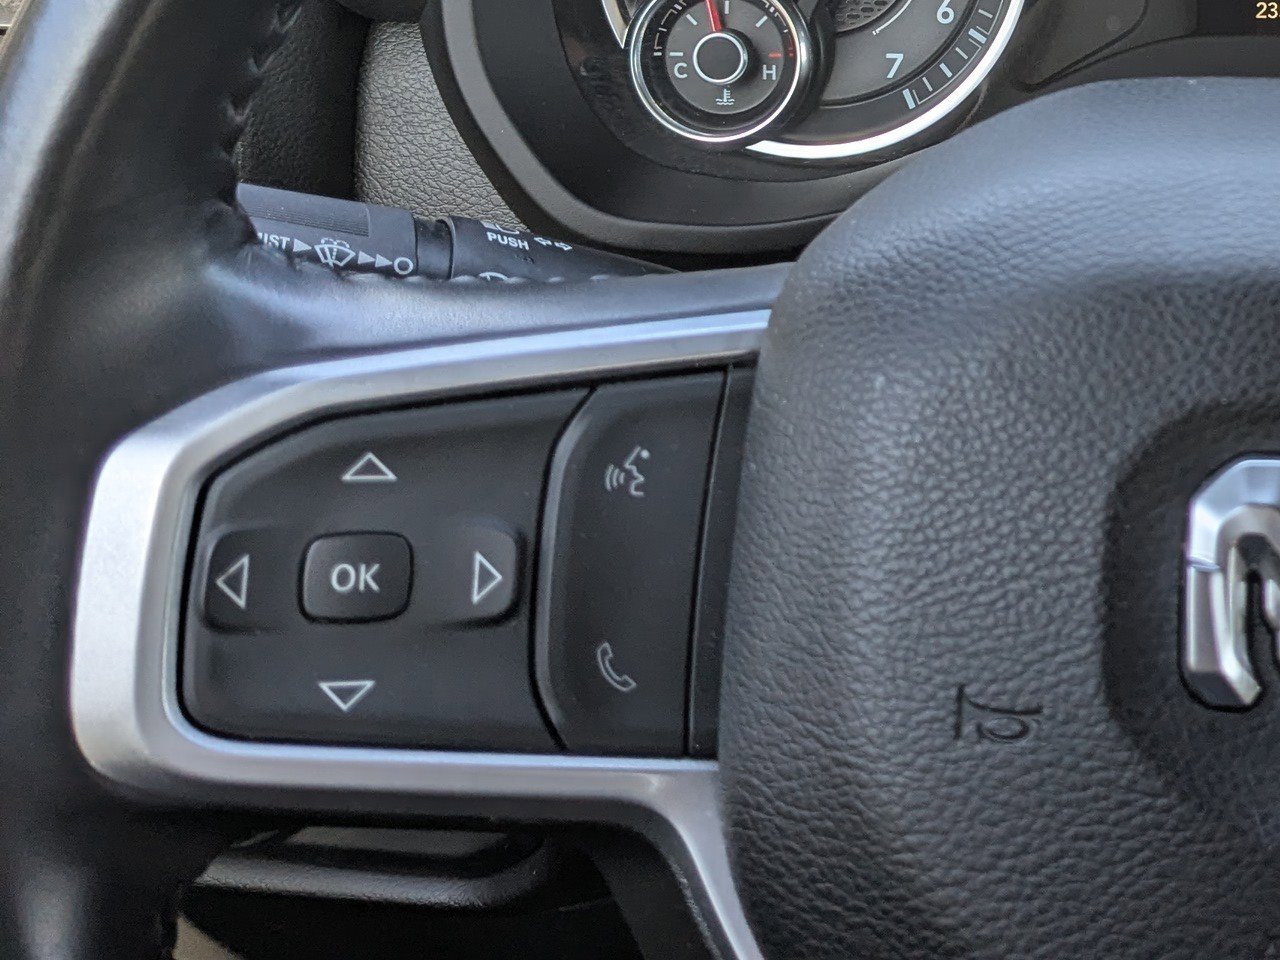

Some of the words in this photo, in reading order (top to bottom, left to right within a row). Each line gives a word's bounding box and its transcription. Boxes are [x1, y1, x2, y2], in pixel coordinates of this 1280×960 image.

[936, 0, 954, 23] 6
[673, 62, 688, 78] C
[762, 65, 777, 80] H
[886, 54, 904, 79] 7
[486, 231, 530, 251] PUSH
[331, 563, 380, 593] OK
